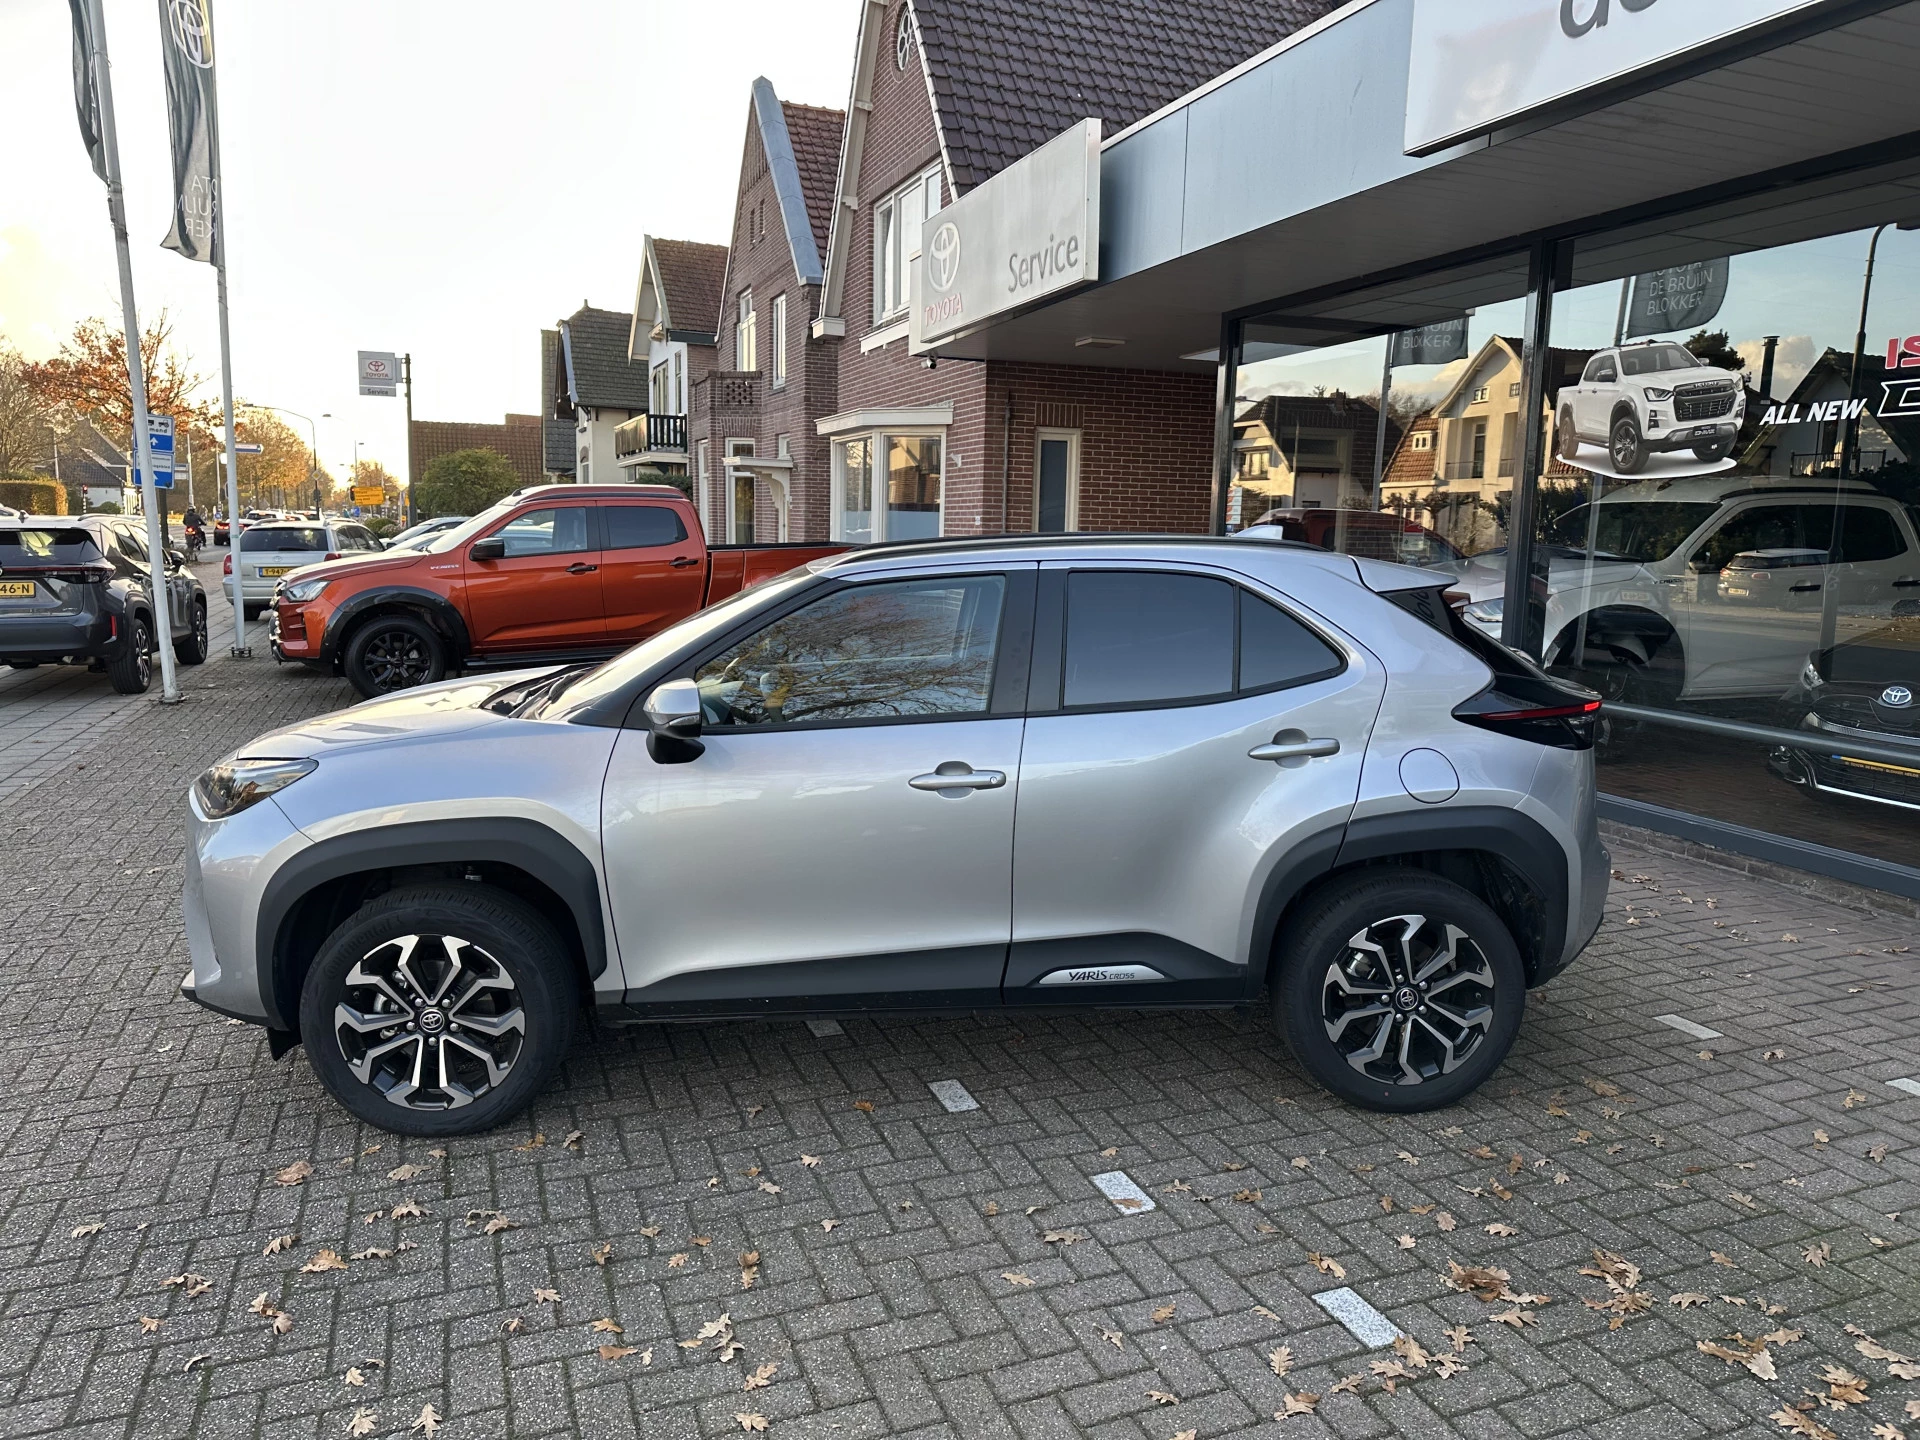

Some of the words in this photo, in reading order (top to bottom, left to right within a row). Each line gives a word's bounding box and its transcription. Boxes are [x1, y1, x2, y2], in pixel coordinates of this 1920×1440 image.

[1008, 233, 1079, 293] Service
[1650, 280, 1664, 297] DE
[1668, 268, 1713, 293] BRUIJN
[924, 294, 963, 328] TOYOTA
[1646, 290, 1704, 316] BLOKKER
[1759, 404, 1802, 426] ALL
[1806, 397, 1869, 423] NEW
[0, 584, 30, 594] 46-N
[1109, 972, 1135, 980] CROSS
